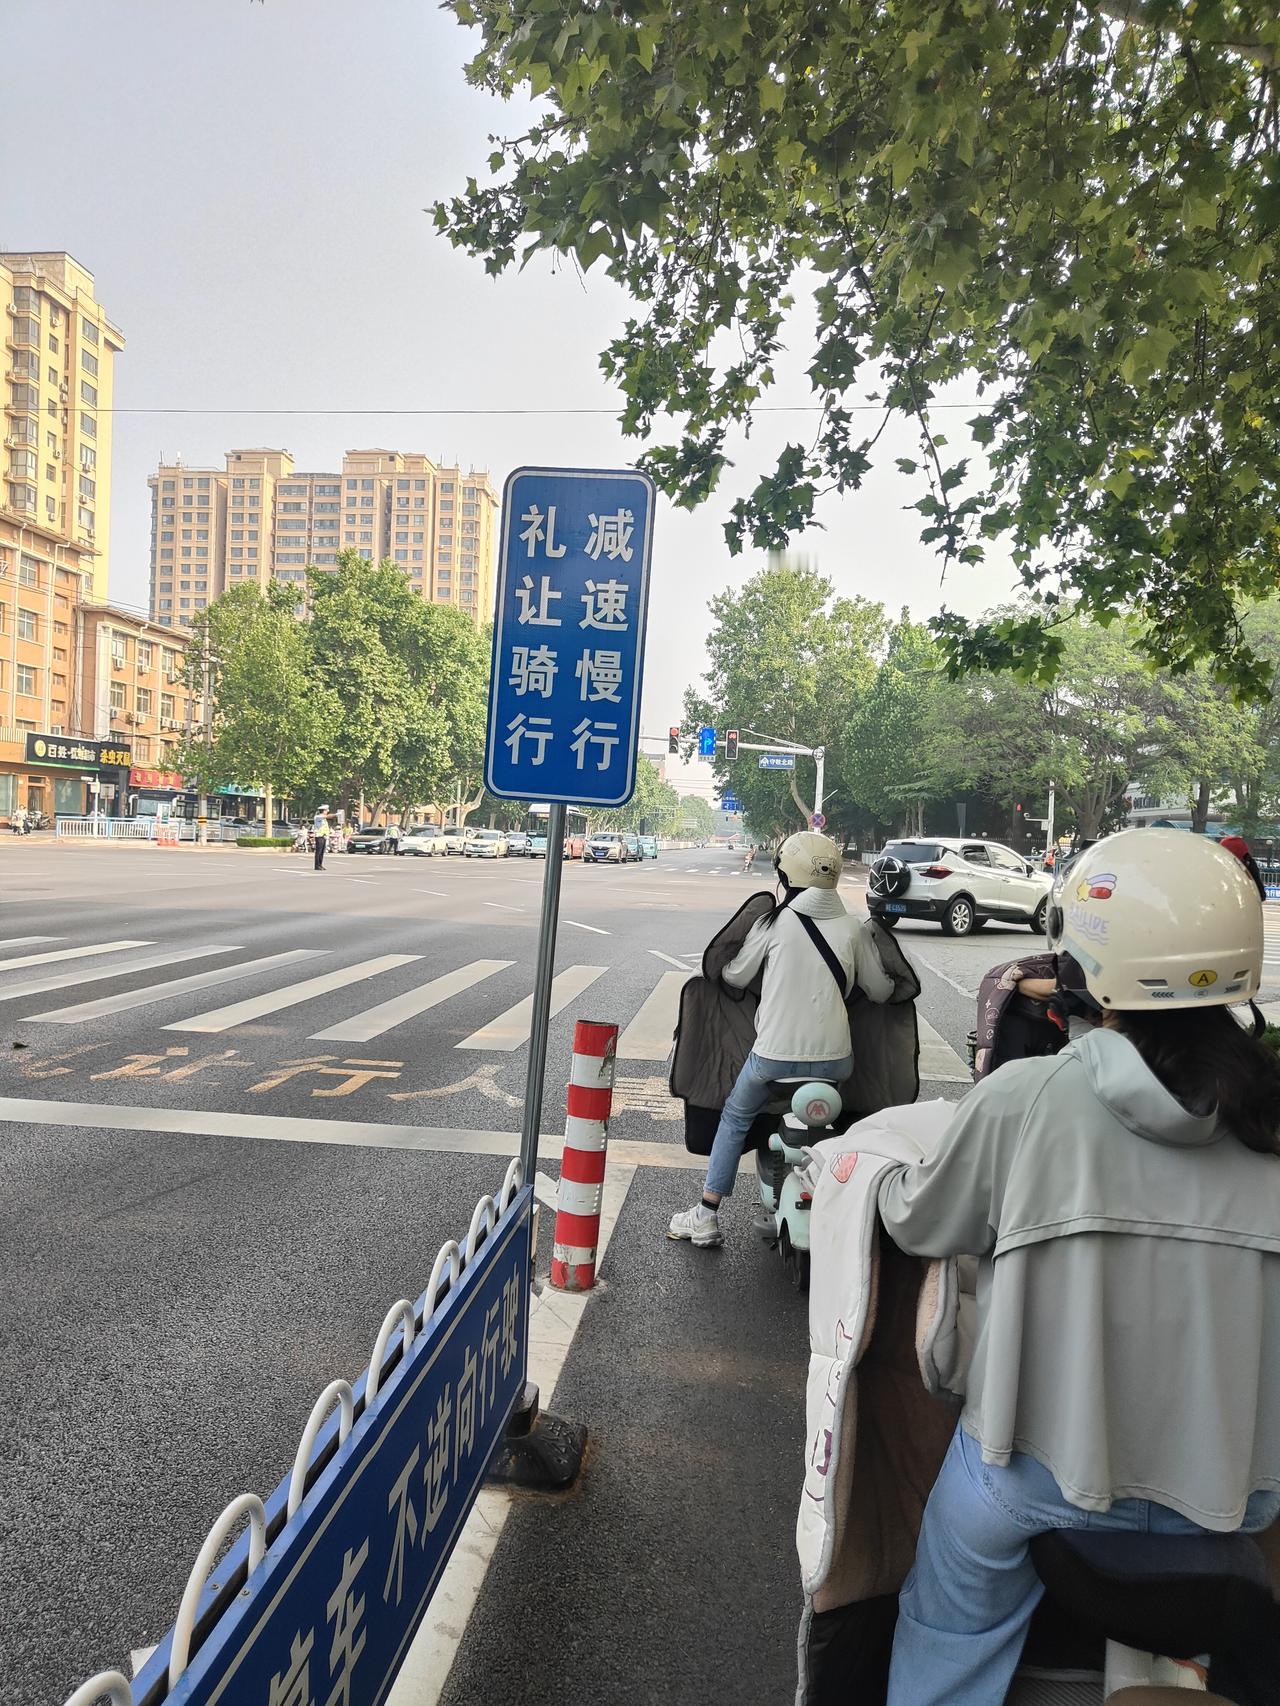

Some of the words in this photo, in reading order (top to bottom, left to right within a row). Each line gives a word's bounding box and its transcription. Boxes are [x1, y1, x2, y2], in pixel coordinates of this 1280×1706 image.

[503, 504, 567, 766] 礼让骑行
[569, 508, 636, 772] 减速慢行
[383, 1262, 519, 1607] 不逆向行驶
